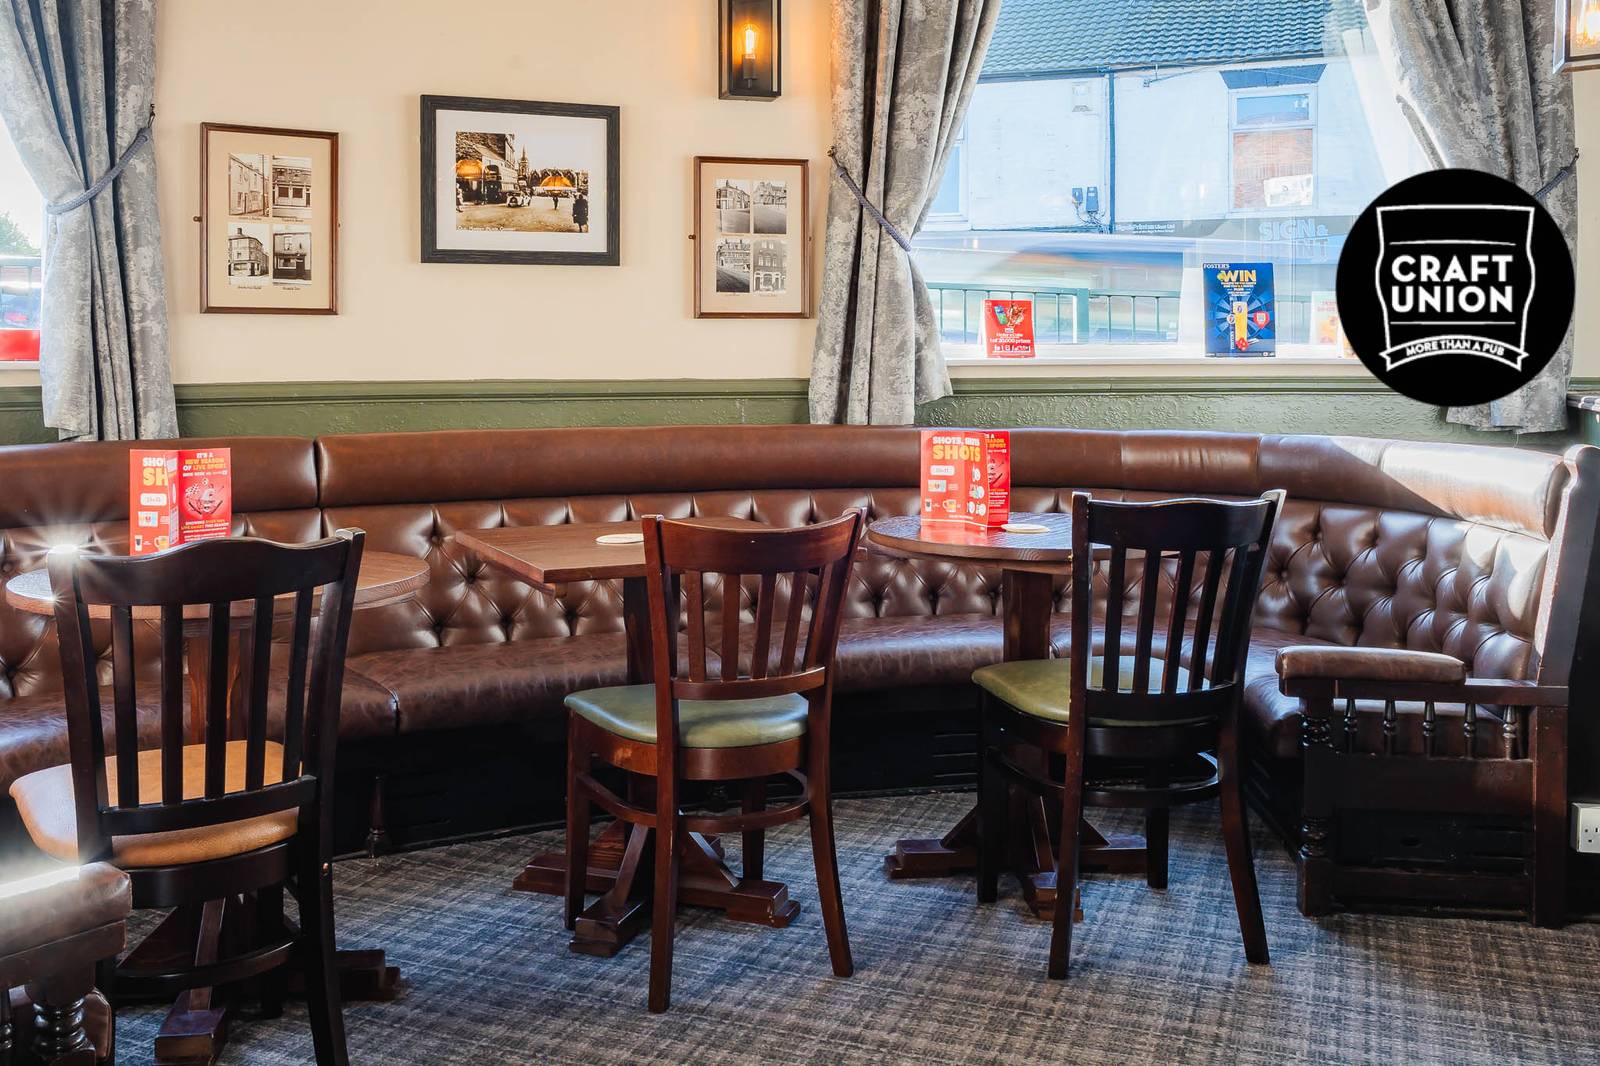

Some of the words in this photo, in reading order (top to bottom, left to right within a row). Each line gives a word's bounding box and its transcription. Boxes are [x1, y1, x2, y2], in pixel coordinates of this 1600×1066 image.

[1259, 218, 1315, 241] SIGN
[1220, 269, 1257, 282] WIN
[142, 457, 167, 467] SHO
[932, 444, 981, 462] SHOTS
[142, 467, 168, 486] SH
